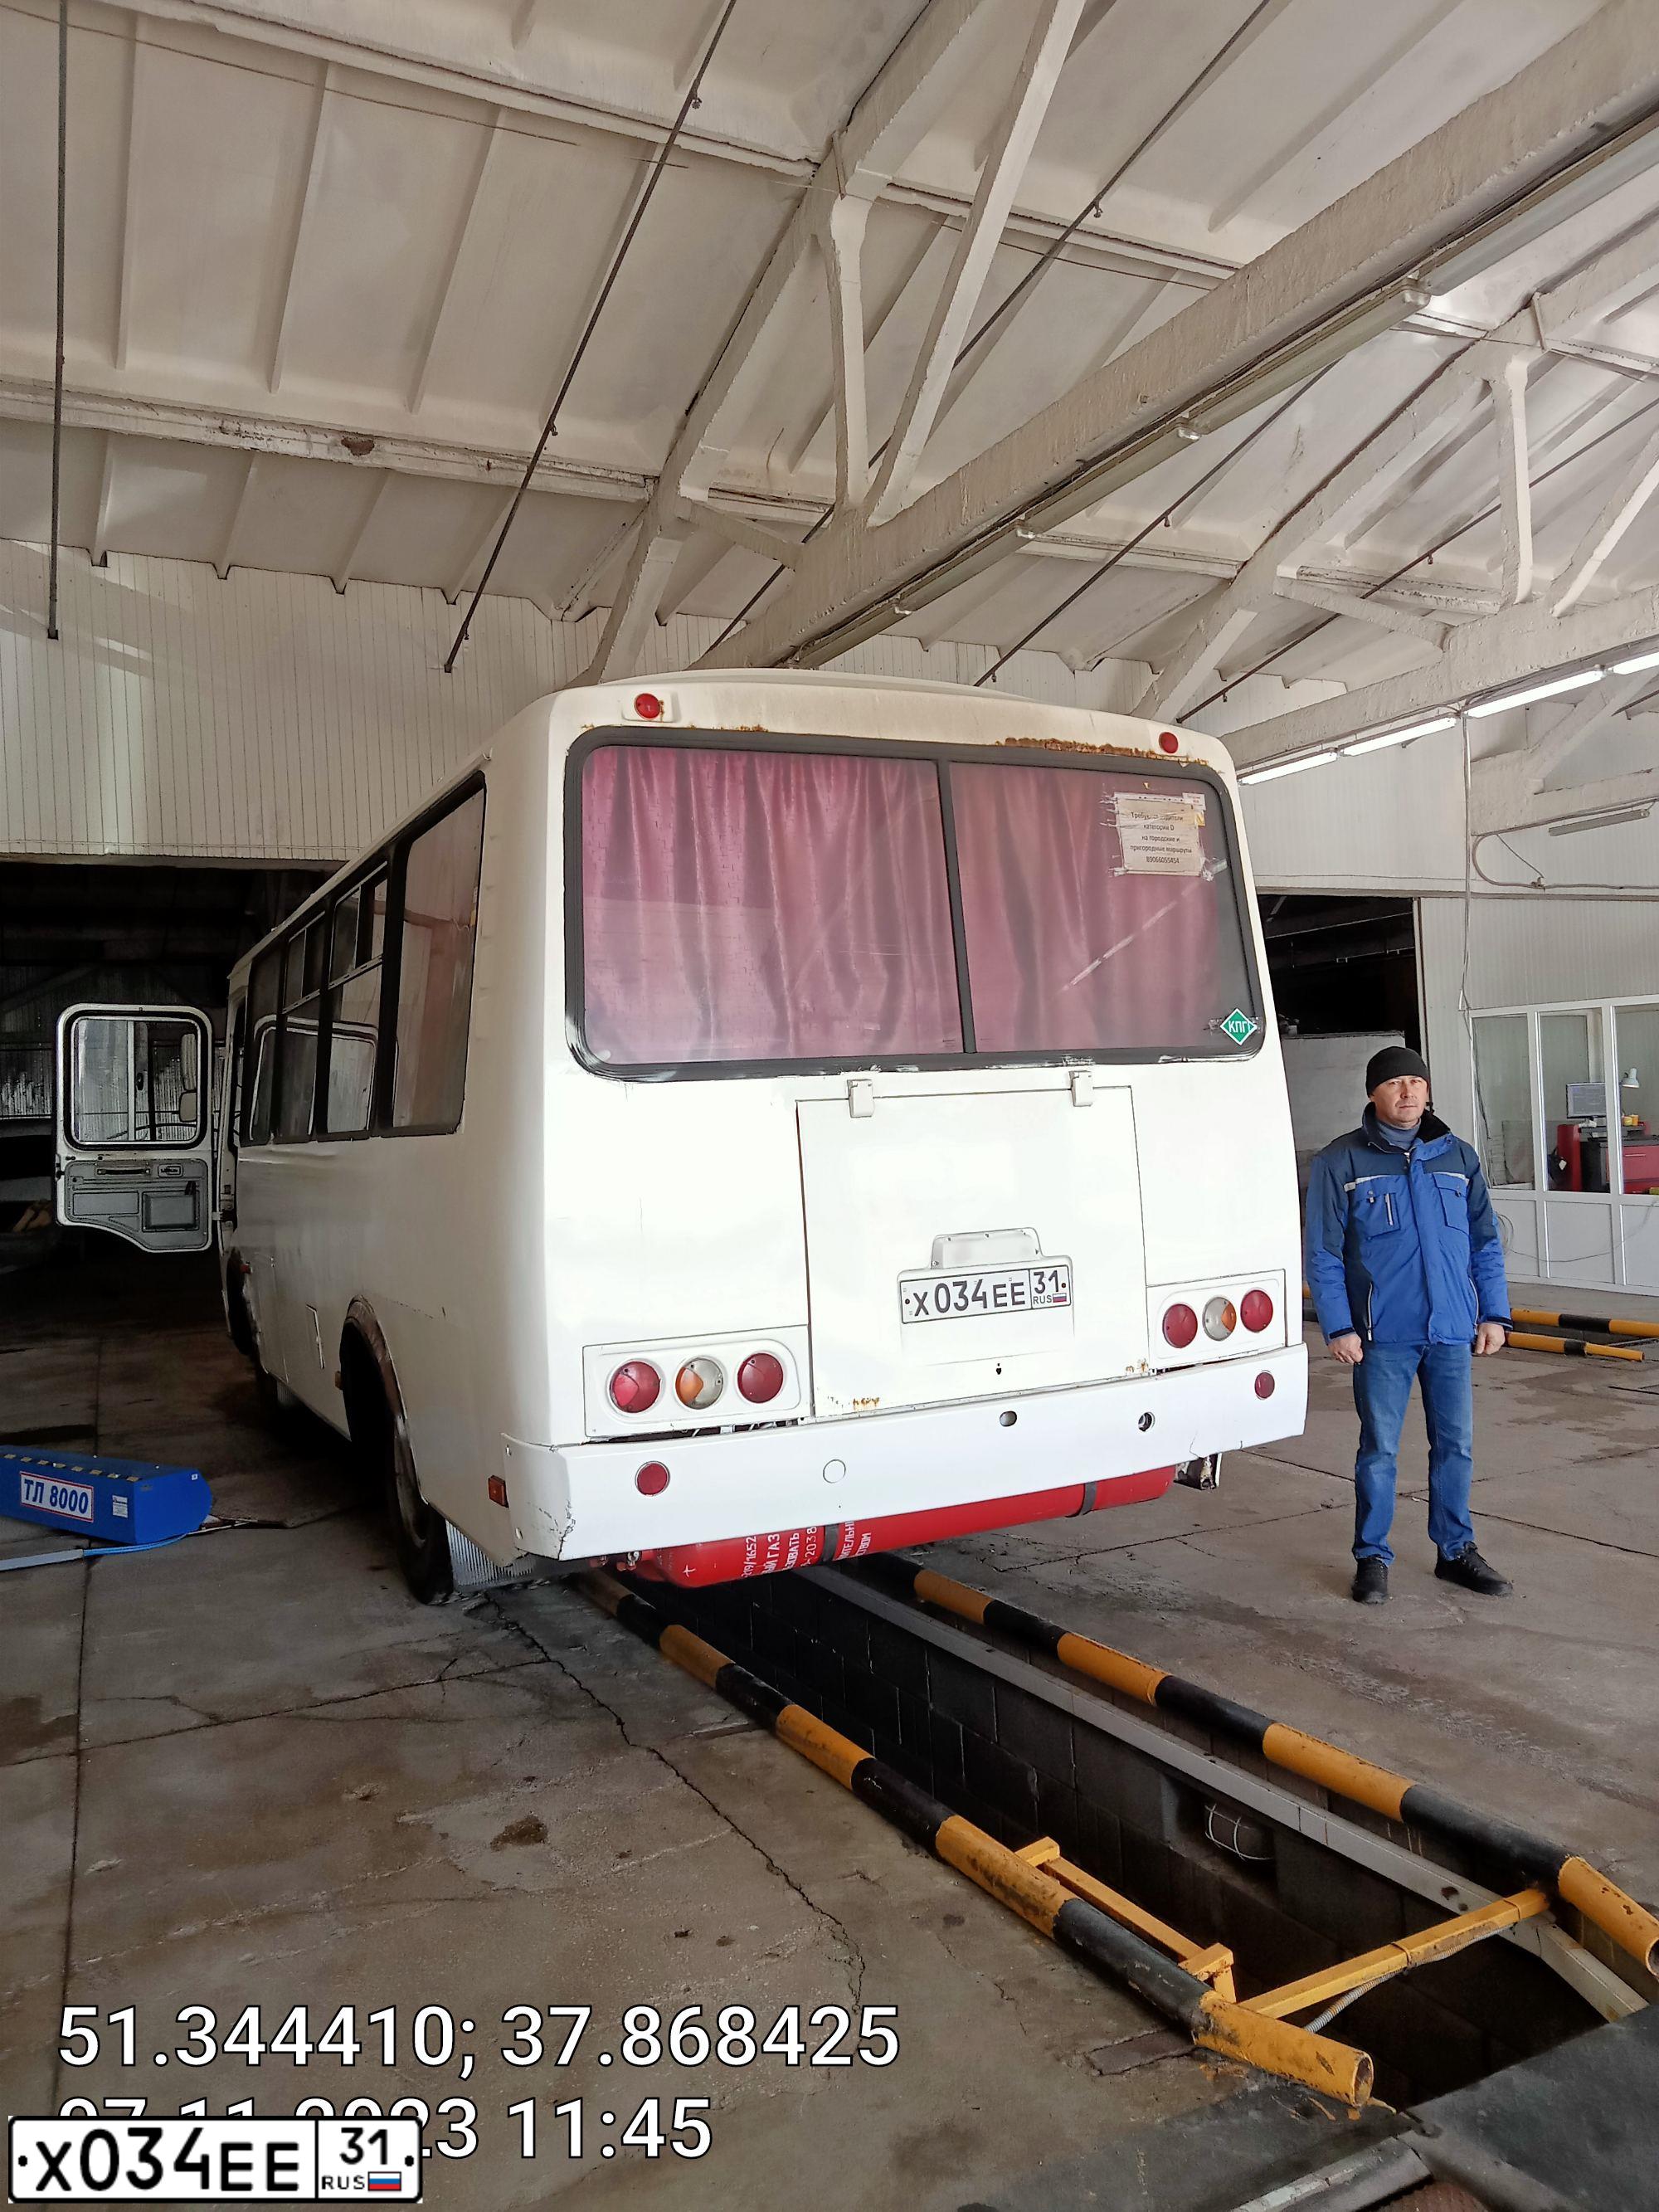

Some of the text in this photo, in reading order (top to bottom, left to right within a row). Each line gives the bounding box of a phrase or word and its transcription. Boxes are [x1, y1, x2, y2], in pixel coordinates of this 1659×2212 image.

[1131, 812, 1159, 821] Требу
[1228, 1020, 1247, 1033] КПГ
[913, 1269, 1060, 1317] Х034ЕЕ 31
[1033, 1294, 1052, 1305] RUS
[24, 1478, 45, 1503] ТЛ
[49, 1485, 89, 1514] 8000
[767, 1533, 780, 1559] ГАЗ
